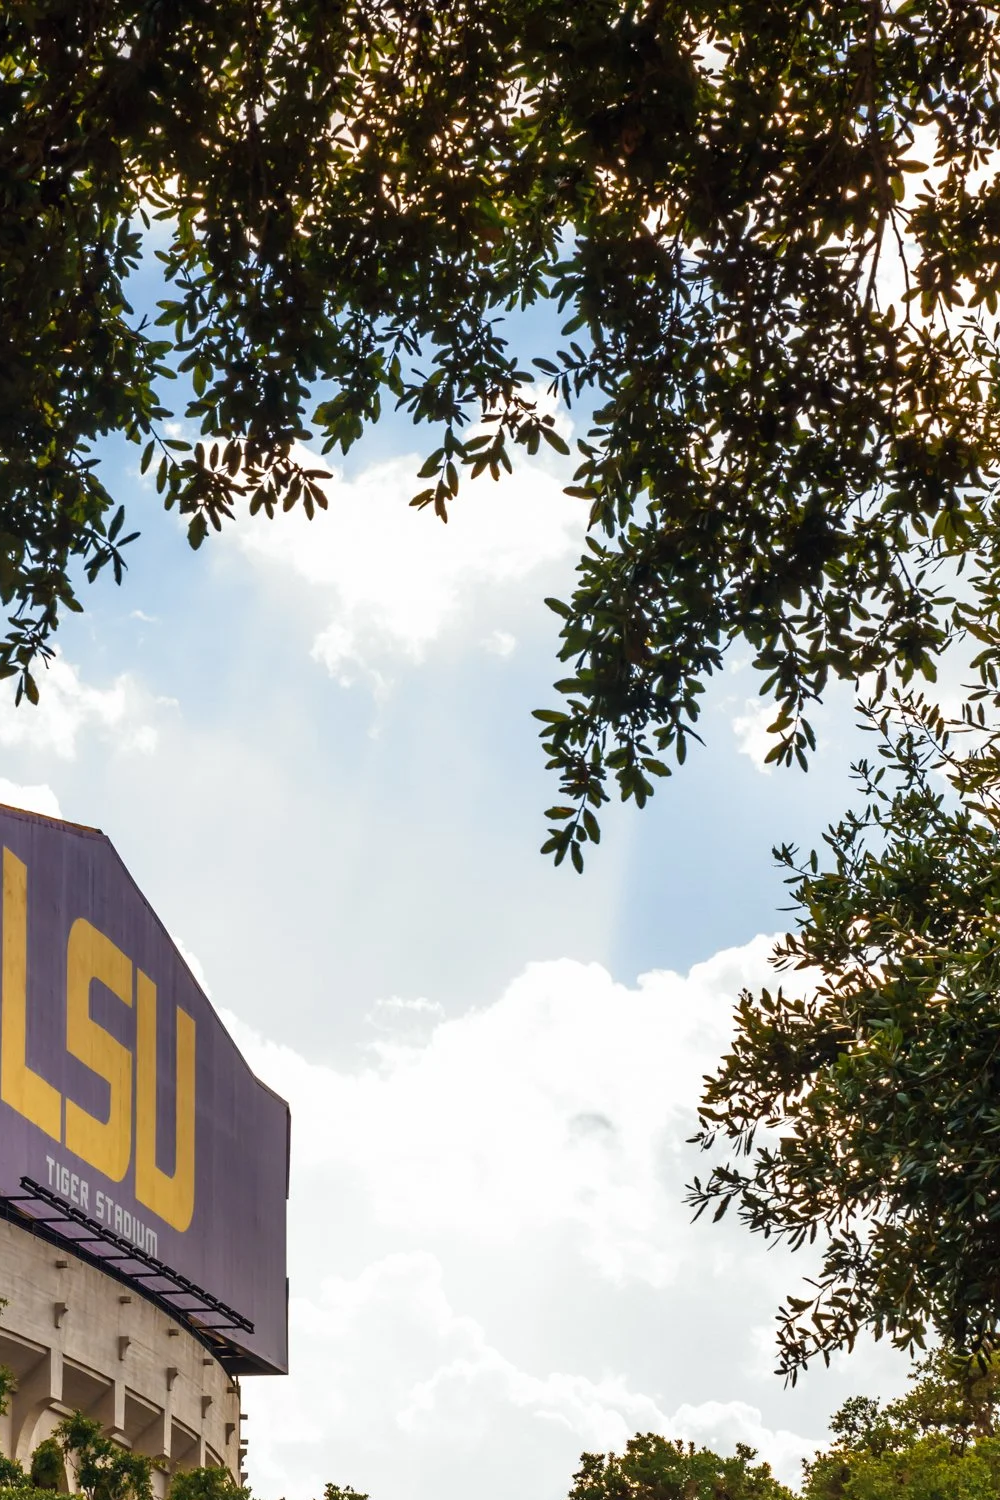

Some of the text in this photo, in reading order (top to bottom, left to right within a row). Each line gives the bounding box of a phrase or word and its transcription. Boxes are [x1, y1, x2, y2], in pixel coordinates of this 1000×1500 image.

[1, 846, 195, 1232] LSU
[46, 1155, 158, 1259] TIGER STADIUM
